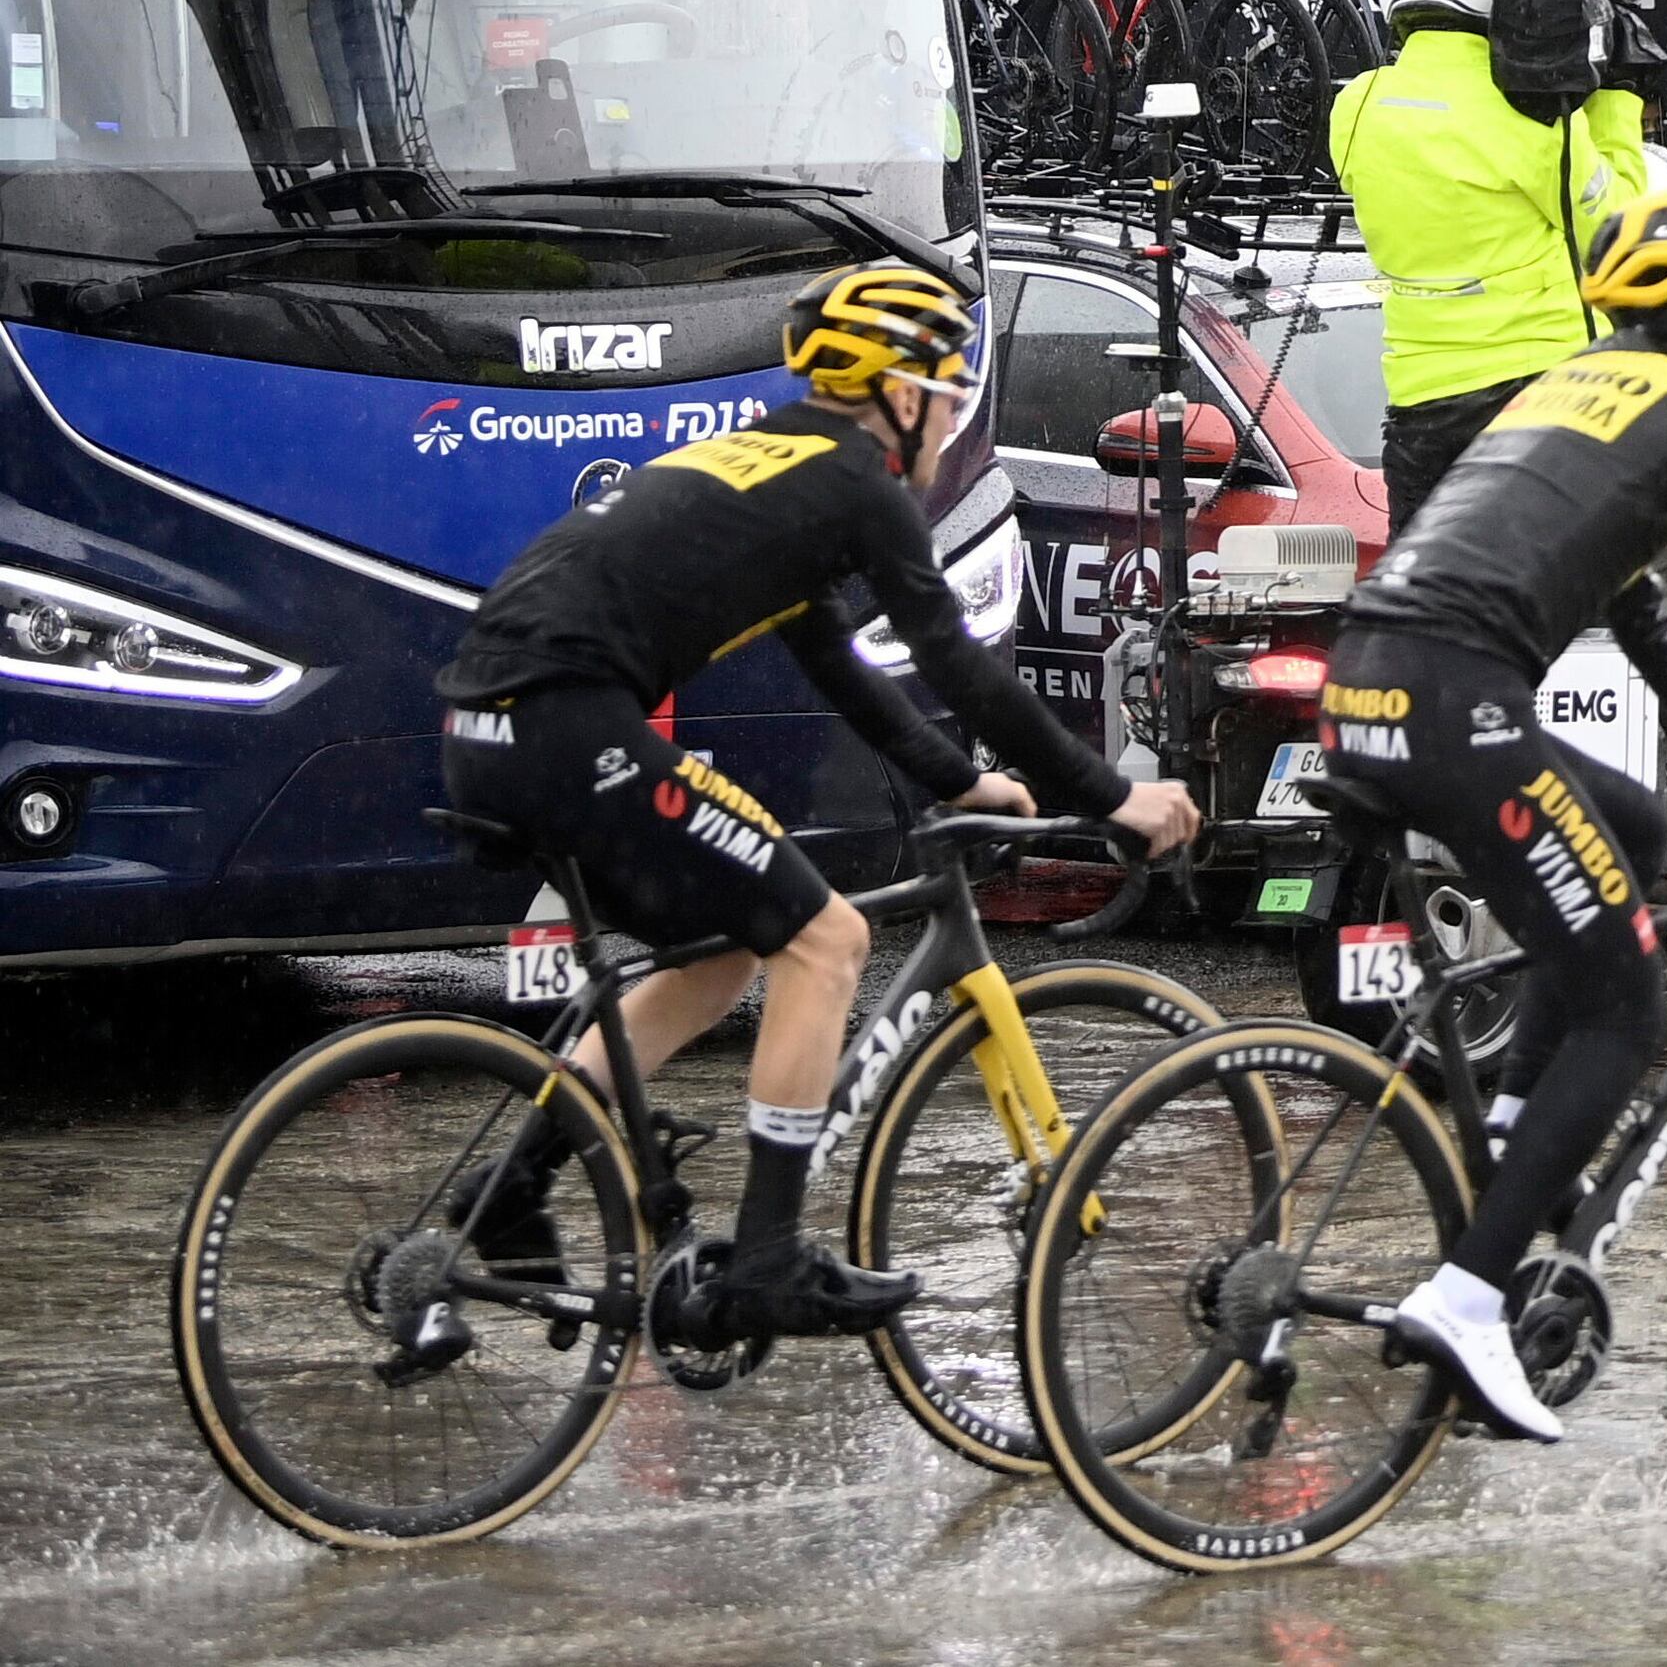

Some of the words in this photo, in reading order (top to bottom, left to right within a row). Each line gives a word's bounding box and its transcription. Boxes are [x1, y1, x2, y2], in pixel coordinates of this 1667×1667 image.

[936, 46, 947, 70] 2
[469, 405, 644, 448] Groupama
[665, 401, 735, 443] FDJ
[1552, 690, 1617, 723] EMG
[673, 754, 786, 838] JUMBO
[686, 801, 776, 874] VISMA
[1520, 769, 1631, 906] JUMBO
[1526, 830, 1601, 934] VISMA
[515, 945, 571, 999] 148
[1349, 944, 1406, 998] 143
[1215, 1046, 1326, 1072] RESERVE
